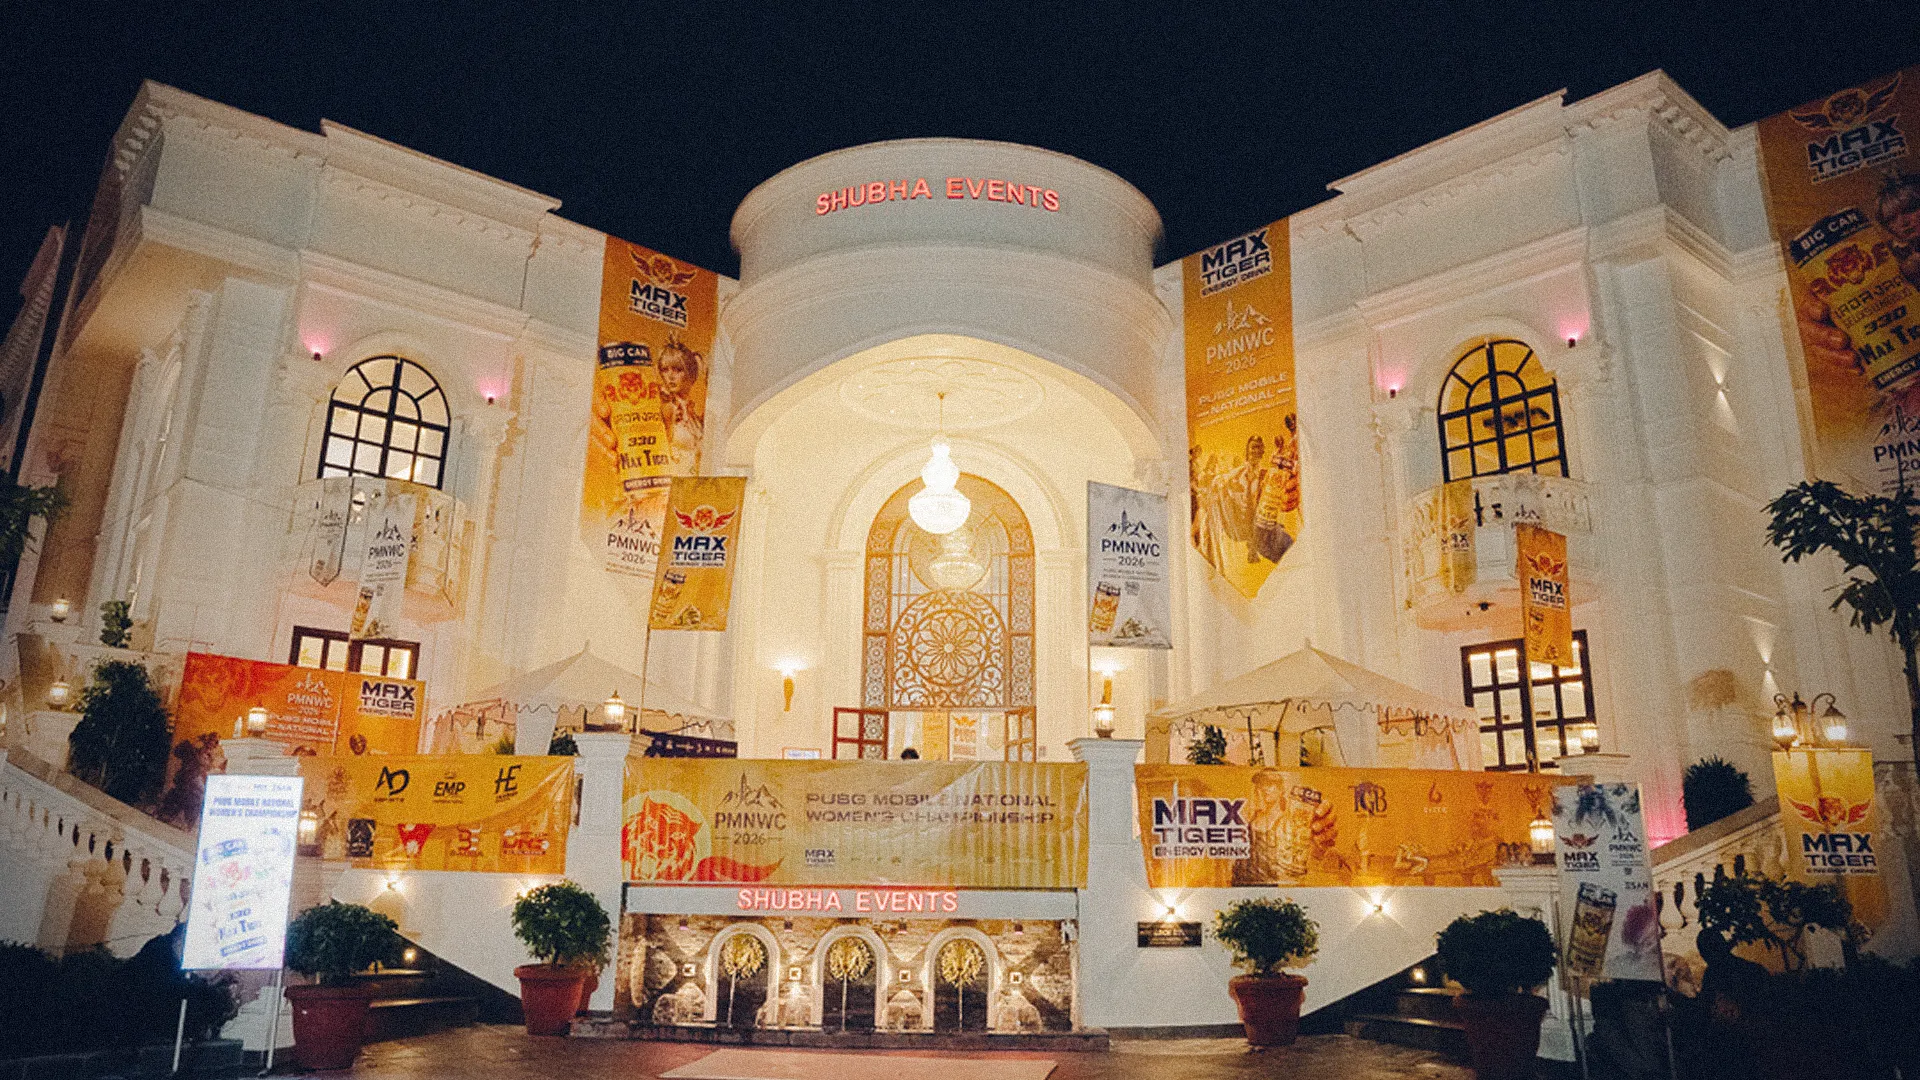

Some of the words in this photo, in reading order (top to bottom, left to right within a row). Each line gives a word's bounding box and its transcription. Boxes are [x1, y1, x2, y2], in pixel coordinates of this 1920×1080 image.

[1807, 115, 1901, 162] MAX
[1810, 136, 1906, 173] TIGER
[816, 177, 932, 216] SHUBHA
[945, 177, 1061, 212] EVENTS
[1801, 229, 1825, 250] BIG
[1828, 212, 1860, 232] CAN
[1201, 229, 1269, 273] MAX
[1201, 251, 1271, 285] TIGER
[631, 279, 688, 312] MAX
[630, 295, 688, 323] TIGER
[606, 348, 625, 359] BIG
[627, 347, 649, 358] CAN
[1206, 327, 1276, 366] PMNWC
[1225, 353, 1257, 375] 2026
[1211, 389, 1275, 415] NATIONAL
[607, 533, 661, 556] PMNWC
[674, 536, 727, 551] MAX
[1101, 538, 1161, 557] PMNWC
[673, 551, 726, 562] TIGER
[1118, 556, 1146, 568] 2026
[1530, 577, 1563, 596] MAX
[1531, 591, 1566, 605] TIGER
[361, 680, 416, 701] MAX
[361, 696, 415, 712] TIGER
[433, 781, 467, 797] EMP
[806, 793, 866, 806] PUBG
[714, 812, 787, 831] PMNWC
[806, 810, 895, 823] WOMEN'S
[1155, 800, 1247, 826] MAX
[733, 833, 766, 846] 2026
[1153, 827, 1249, 844] TIGER
[1802, 833, 1874, 854] MAX
[805, 849, 835, 858] MAX
[1155, 846, 1205, 857] ENERGY
[1209, 846, 1249, 857] DRINK
[1563, 852, 1599, 863] MAX
[1804, 854, 1877, 867] TIGER
[737, 888, 842, 912] SHUBHA
[856, 890, 959, 913] EVENTS
